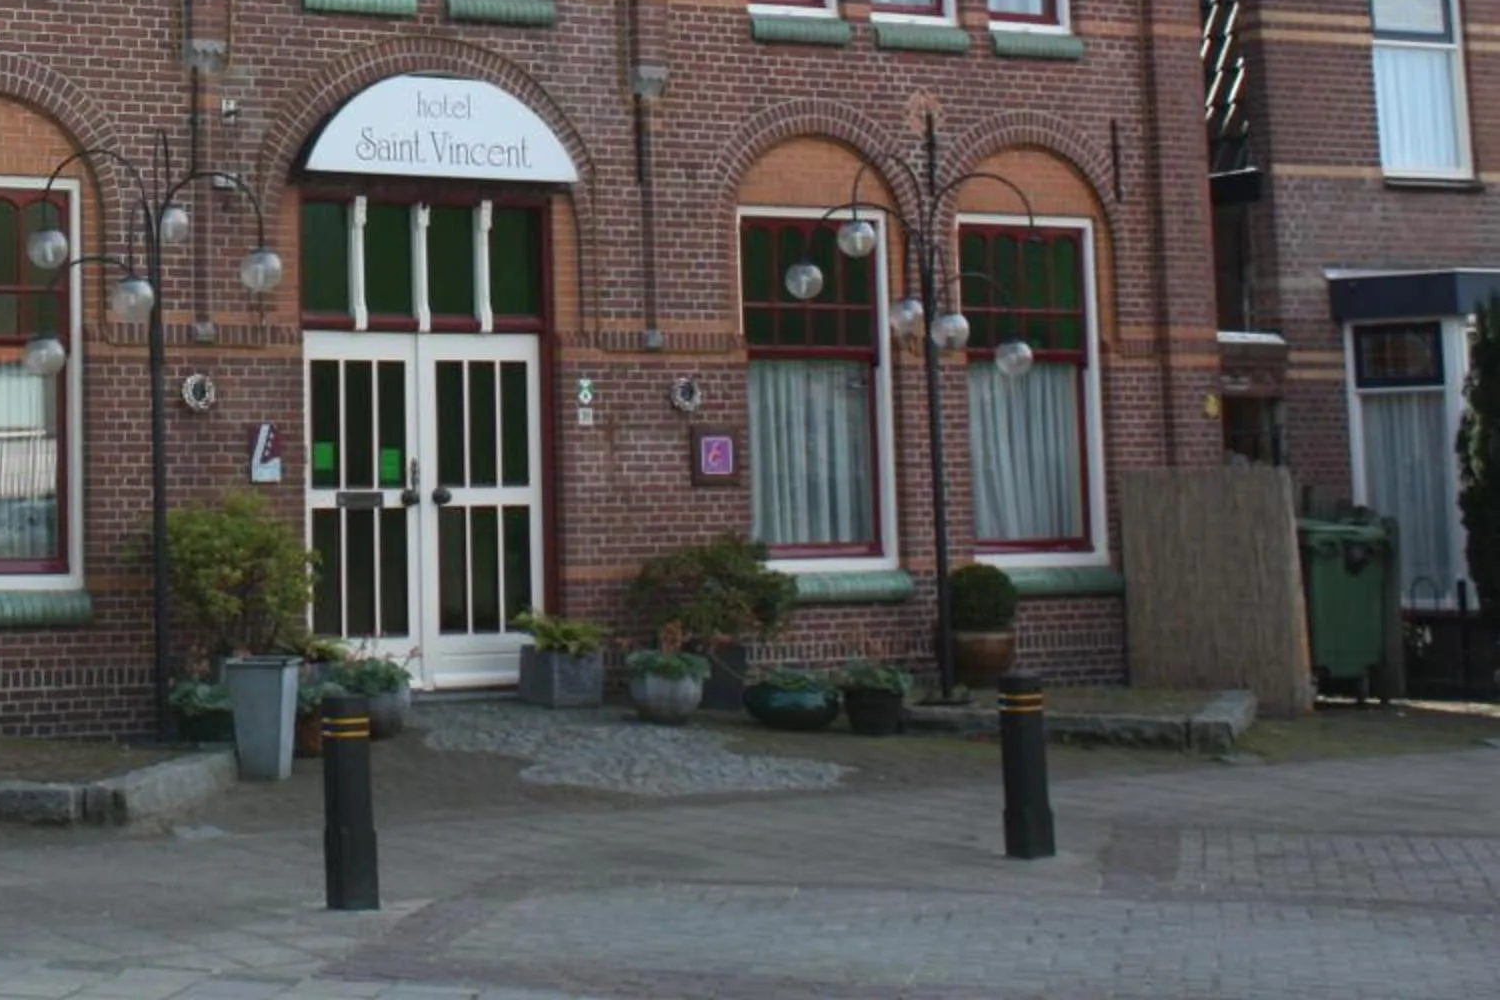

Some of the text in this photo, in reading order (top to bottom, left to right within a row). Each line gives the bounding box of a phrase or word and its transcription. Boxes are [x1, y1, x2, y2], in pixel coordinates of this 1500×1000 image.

[417, 91, 472, 119] hotel
[355, 127, 532, 169] Saint Vincent
